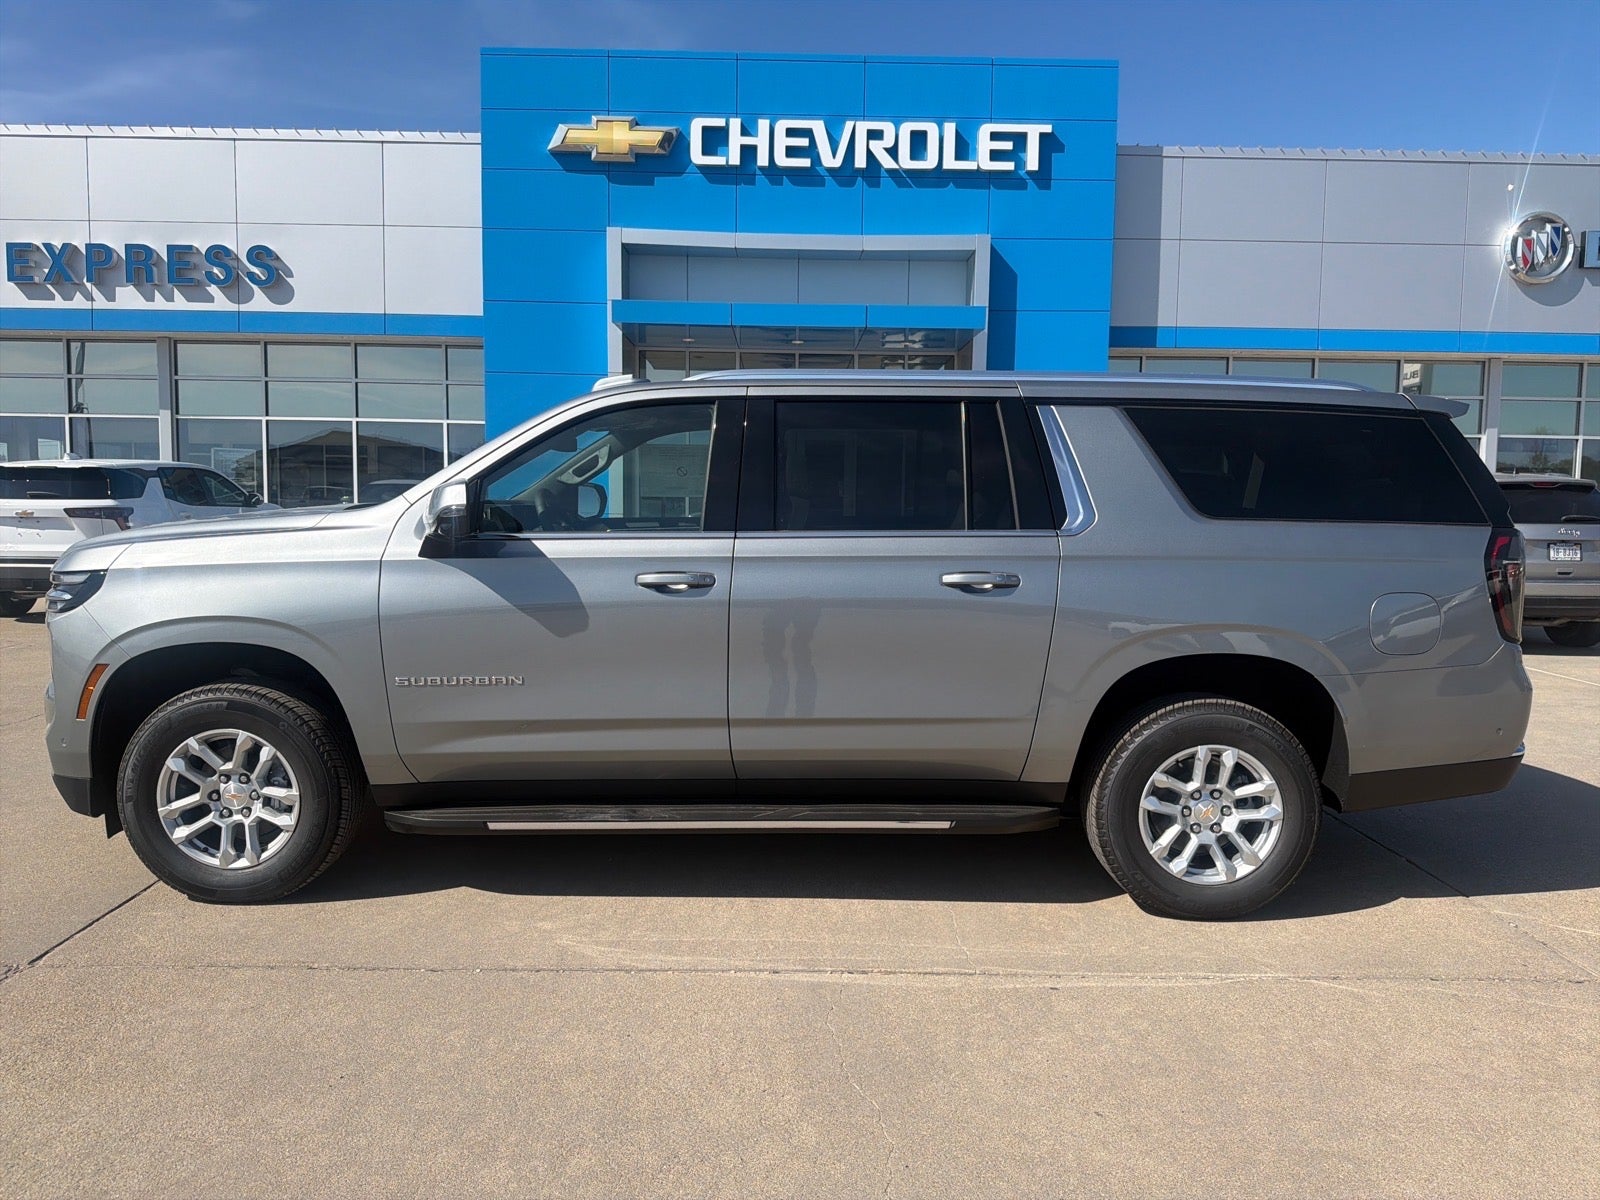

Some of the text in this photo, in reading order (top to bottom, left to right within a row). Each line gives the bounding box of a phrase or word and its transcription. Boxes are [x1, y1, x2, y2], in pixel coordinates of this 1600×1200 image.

[689, 117, 1053, 172] CHEVROLET
[5, 241, 278, 288] EXPRESS
[394, 675, 525, 686] SUBURBAN
